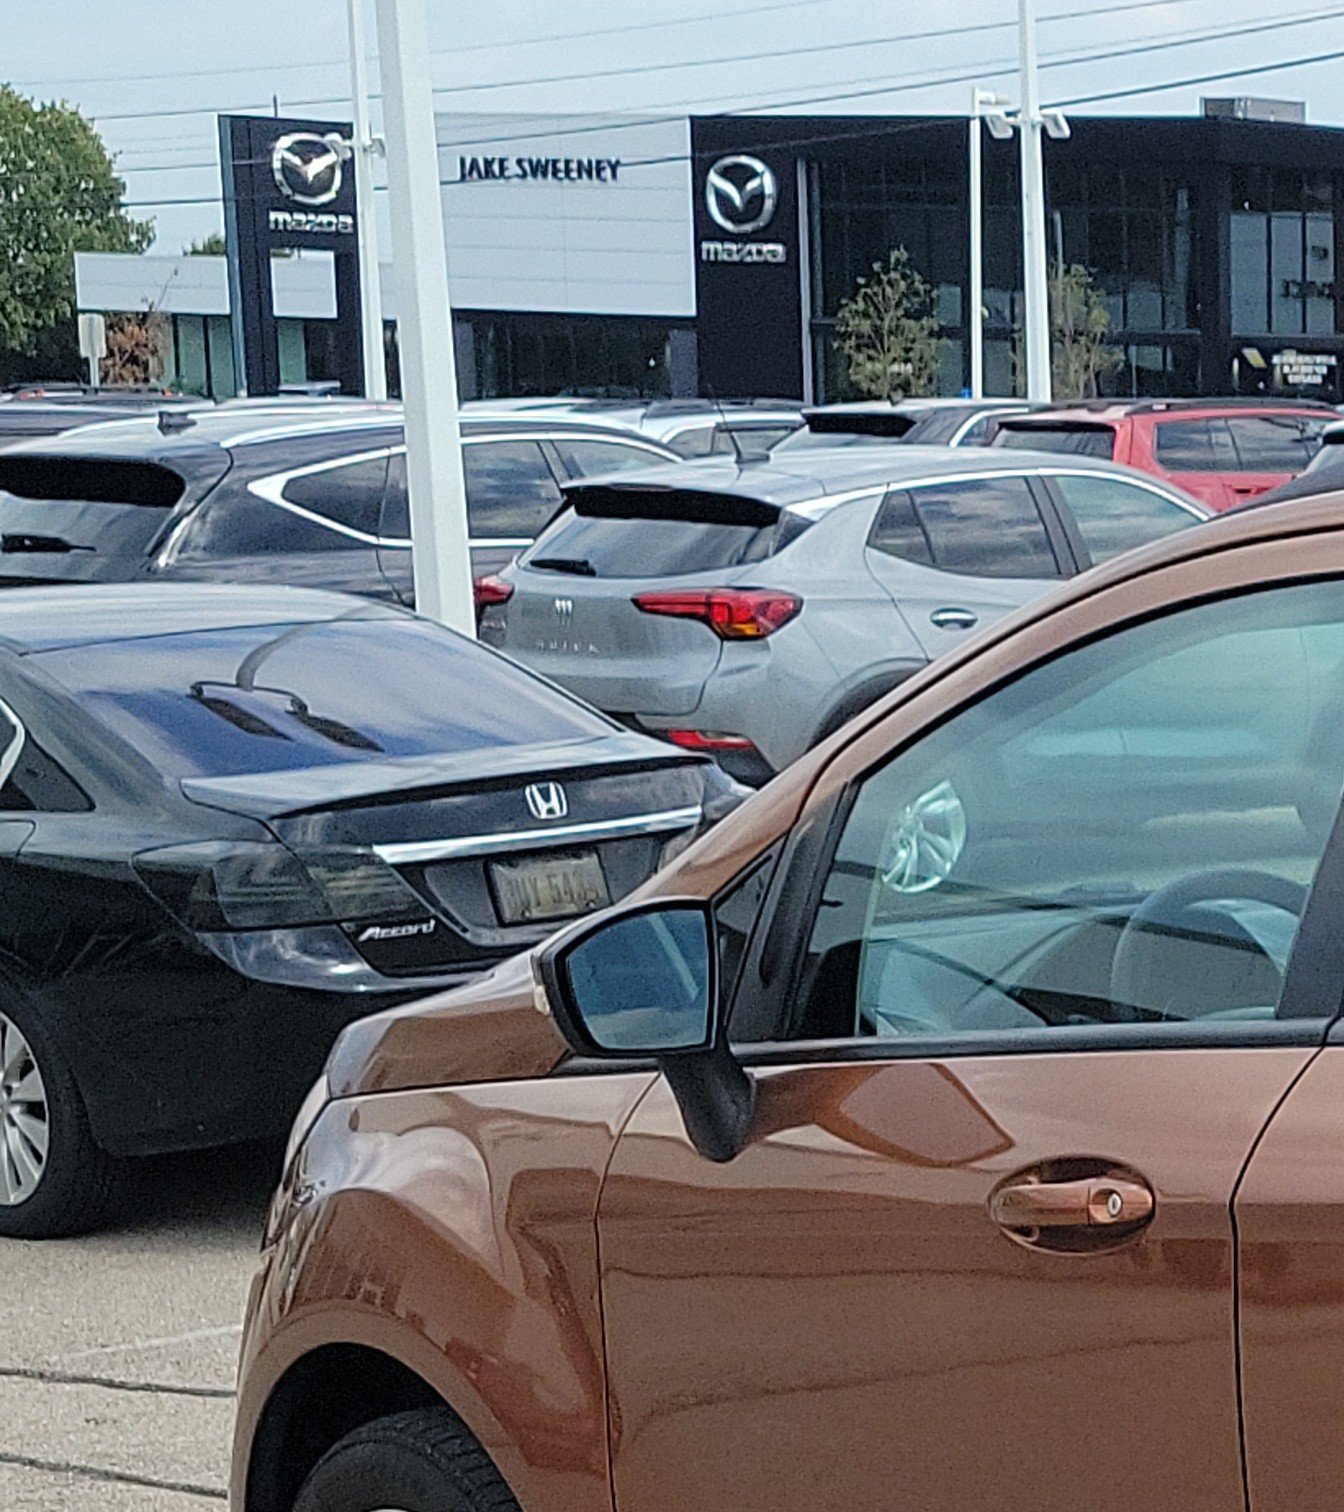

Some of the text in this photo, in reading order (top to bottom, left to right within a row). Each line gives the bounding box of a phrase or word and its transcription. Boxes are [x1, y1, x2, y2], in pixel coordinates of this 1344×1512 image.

[459, 157, 621, 183] JAKE SWEENEY
[269, 210, 354, 233] mazda
[702, 241, 786, 263] mazda
[358, 919, 436, 942] Accord
